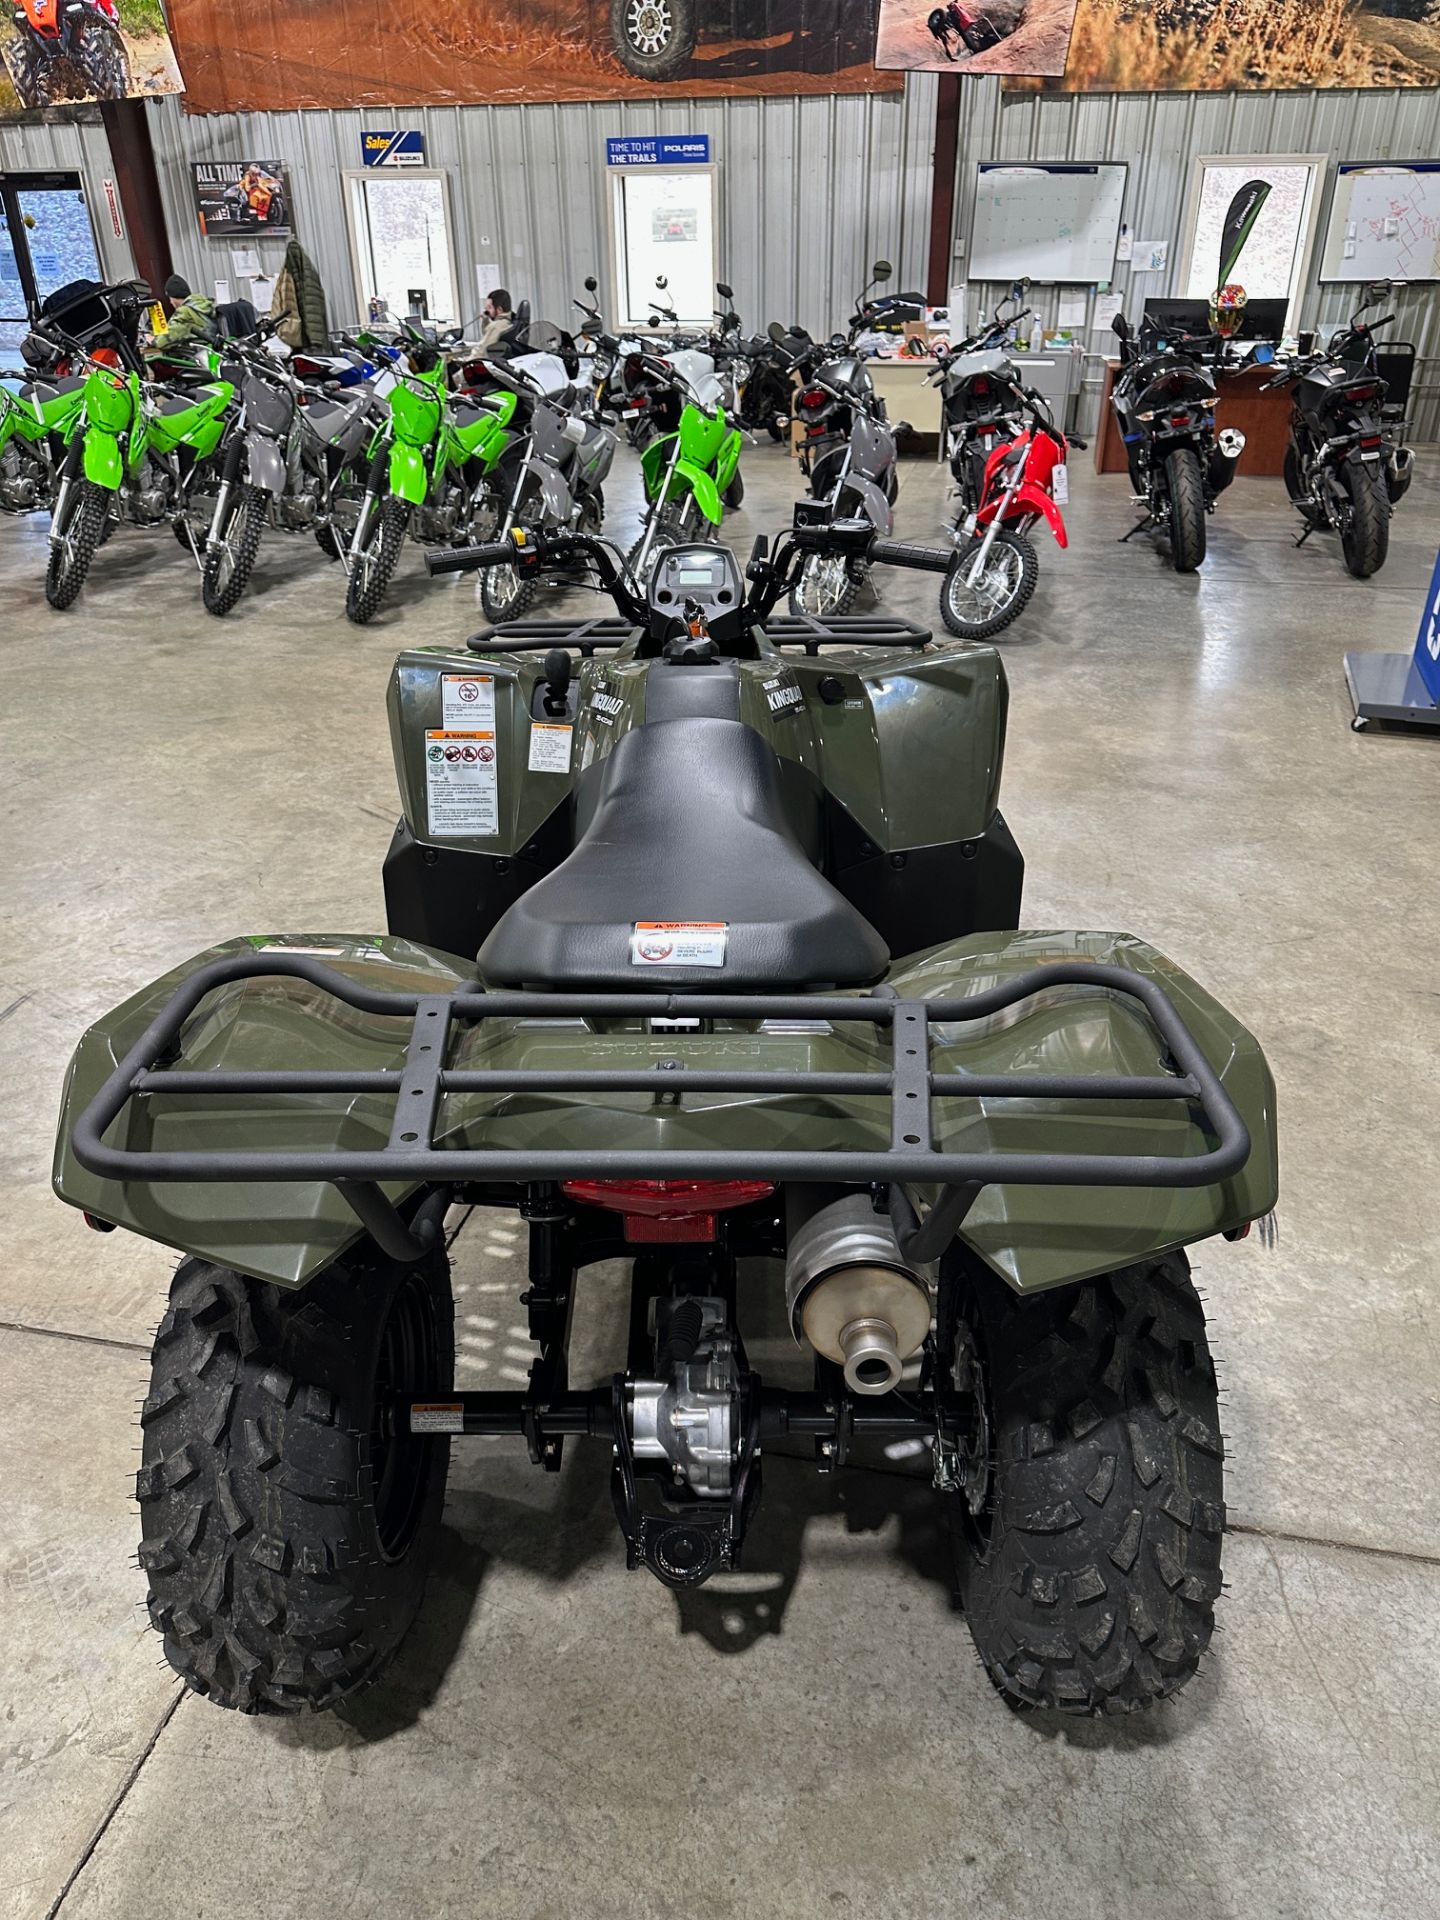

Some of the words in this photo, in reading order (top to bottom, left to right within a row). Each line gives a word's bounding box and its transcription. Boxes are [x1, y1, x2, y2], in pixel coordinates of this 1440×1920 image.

[365, 135, 391, 149] Sales
[609, 143, 630, 153] TIME
[630, 142, 641, 152] TO
[642, 141, 656, 152] HIT
[664, 144, 706, 152] POLARIS
[610, 154, 627, 164] THE
[628, 153, 657, 163] TRAILS
[196, 164, 216, 182] ALL
[215, 164, 243, 182] TIME
[1234, 191, 1259, 230] Kawasaki
